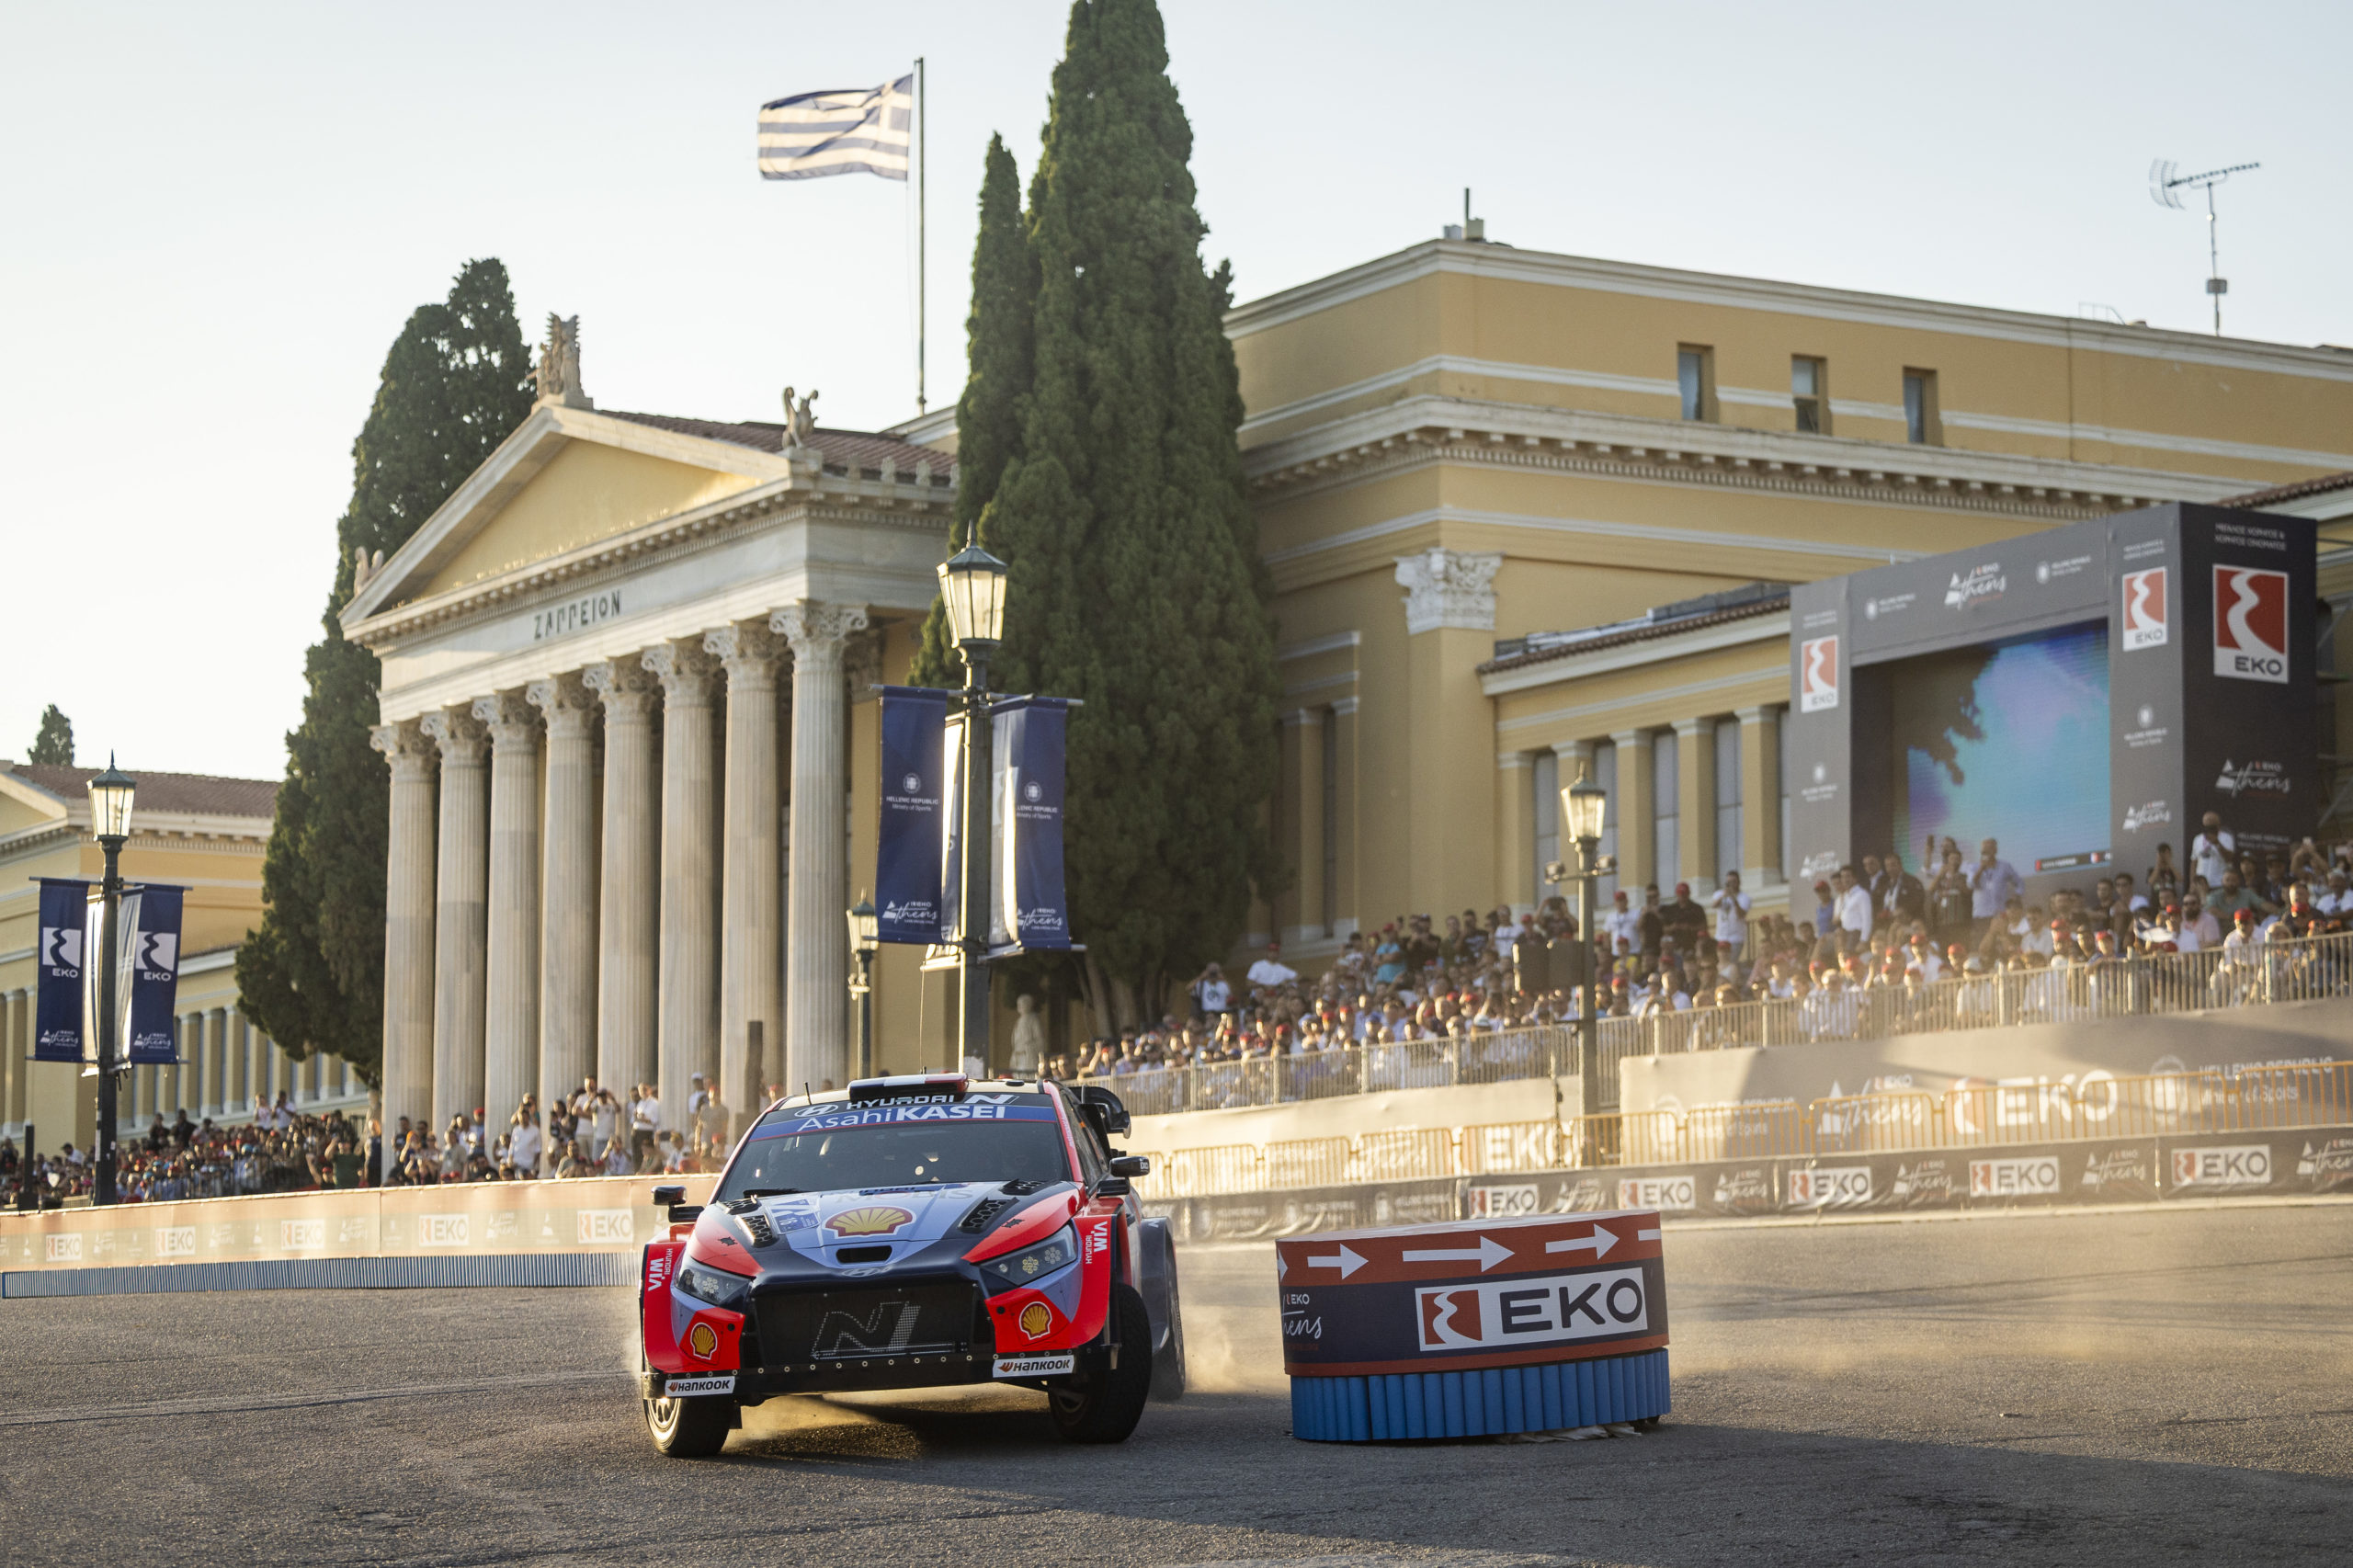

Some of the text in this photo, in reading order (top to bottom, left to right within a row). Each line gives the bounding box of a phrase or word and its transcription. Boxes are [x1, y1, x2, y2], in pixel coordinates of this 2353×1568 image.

[2135, 628, 2164, 644] EKO
[2234, 655, 2282, 676] EKO
[52, 967, 78, 978] EKO
[143, 971, 171, 982] EKO
[846, 1095, 955, 1109] HYUNDAI
[1997, 1069, 2118, 1127] EKO
[797, 1106, 1006, 1131] AsahiKASEI
[2201, 1151, 2268, 1179] EKO
[1814, 1172, 1869, 1196] EKO
[1997, 1163, 2056, 1189] EKO
[1491, 1189, 1536, 1212] EKO
[1643, 1181, 1692, 1206] EKO
[435, 1219, 467, 1237] EKO
[596, 1216, 632, 1237] EKO
[57, 1240, 81, 1257] EKO
[169, 1231, 194, 1251] EKO
[664, 1248, 673, 1275] HYUNDAI
[1290, 1293, 1310, 1305] EKO
[1499, 1278, 1643, 1335] EKO
